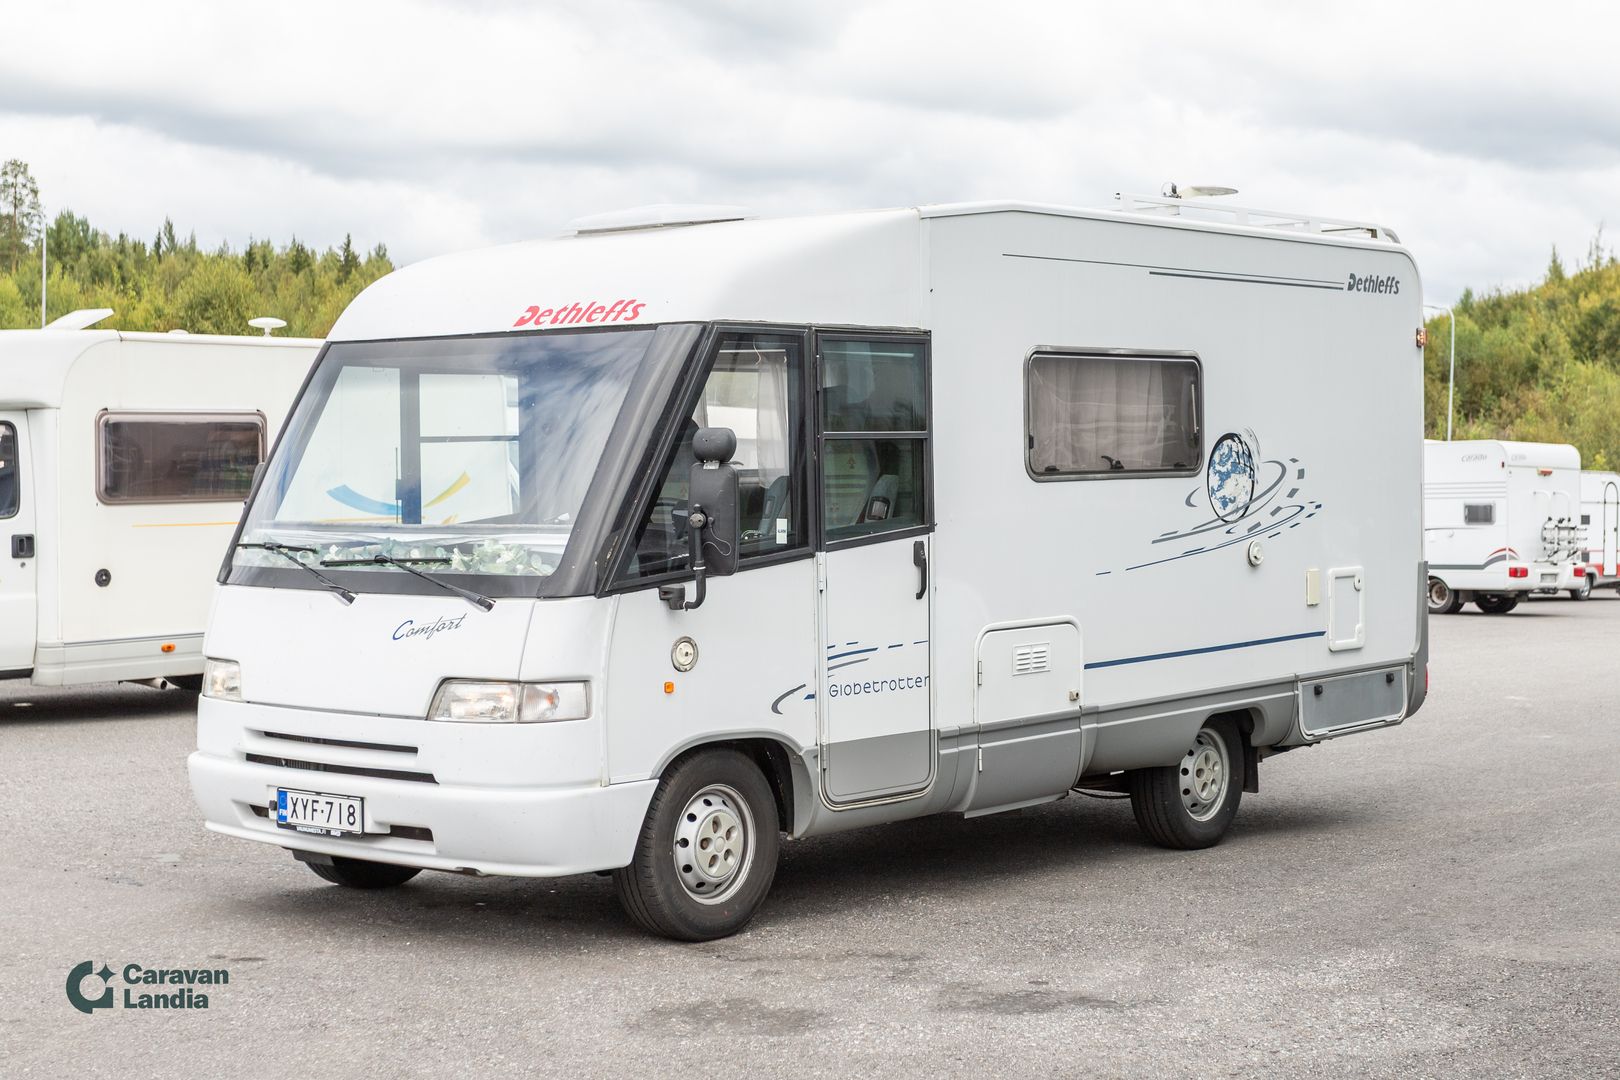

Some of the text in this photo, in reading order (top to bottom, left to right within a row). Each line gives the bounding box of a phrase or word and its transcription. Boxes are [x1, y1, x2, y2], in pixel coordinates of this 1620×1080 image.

[1347, 273, 1400, 295] Dethleffs
[514, 299, 646, 327] Dethleffs
[392, 612, 468, 641] Comfort
[829, 675, 930, 697] Globetrotter
